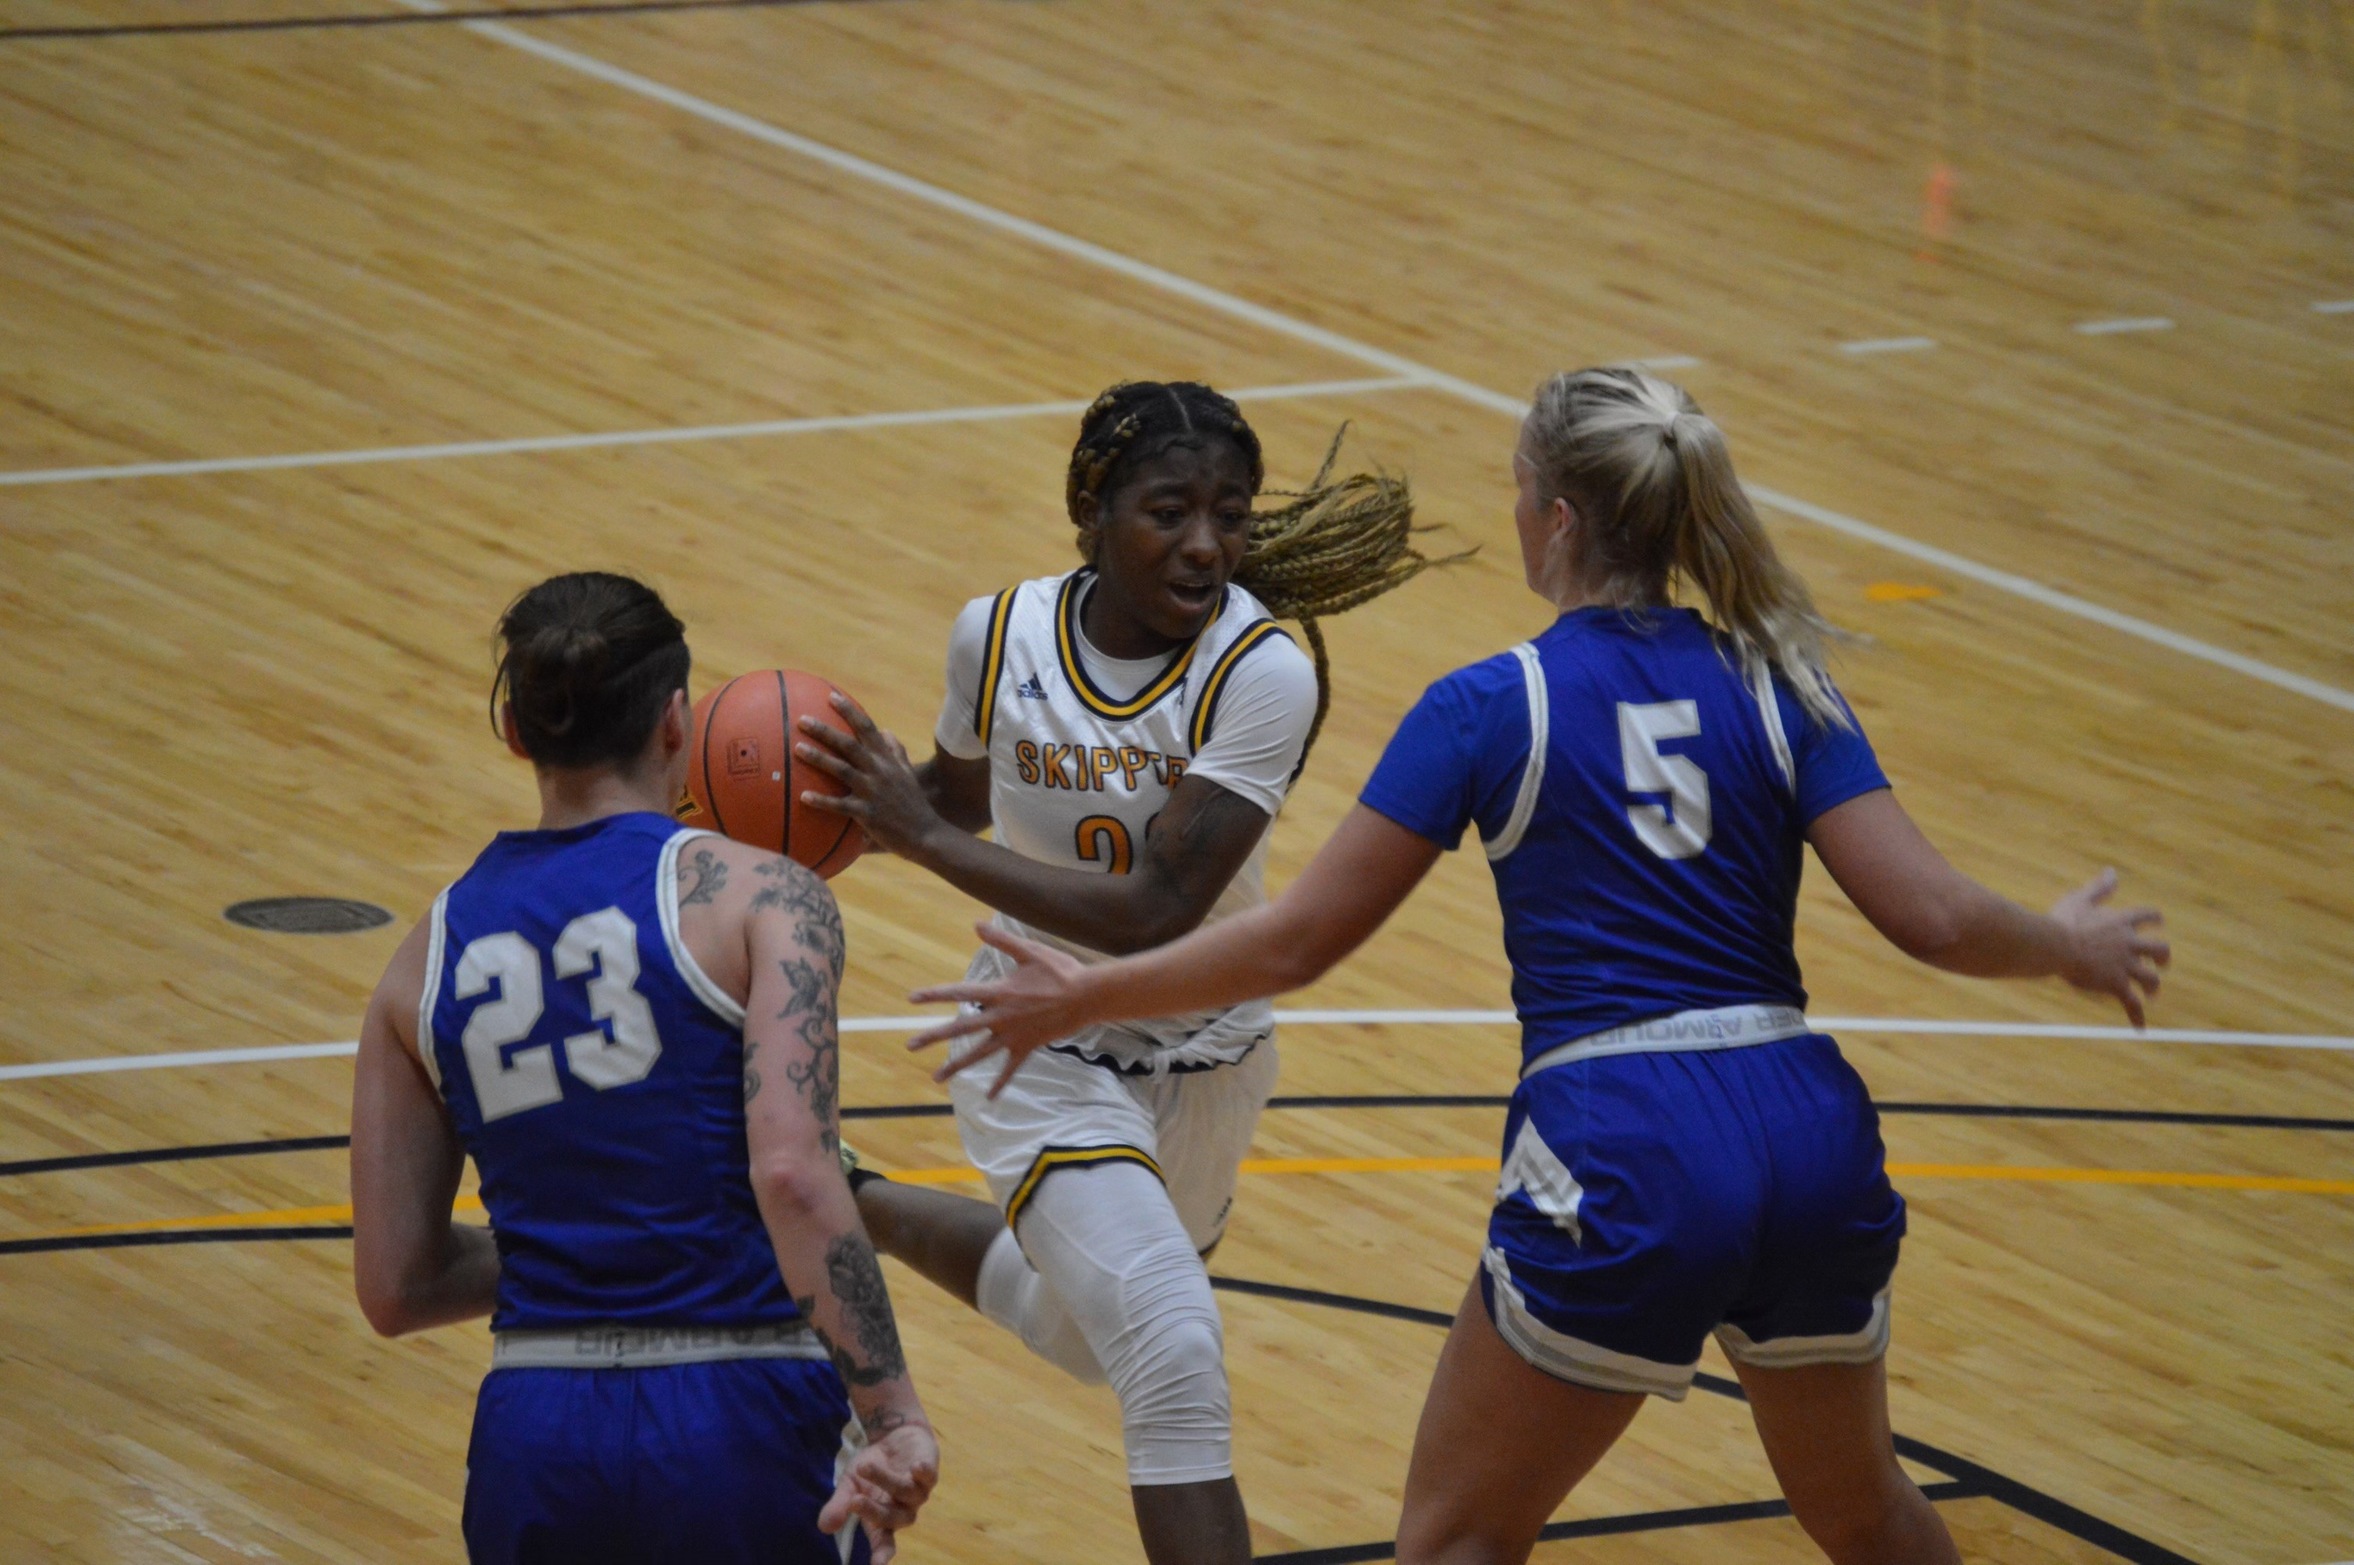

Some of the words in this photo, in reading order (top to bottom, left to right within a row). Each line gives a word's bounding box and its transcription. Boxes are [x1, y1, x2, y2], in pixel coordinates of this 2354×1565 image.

[1016, 688, 1049, 701] adidas
[1616, 699, 1713, 860] 5
[455, 904, 663, 1124] 23
